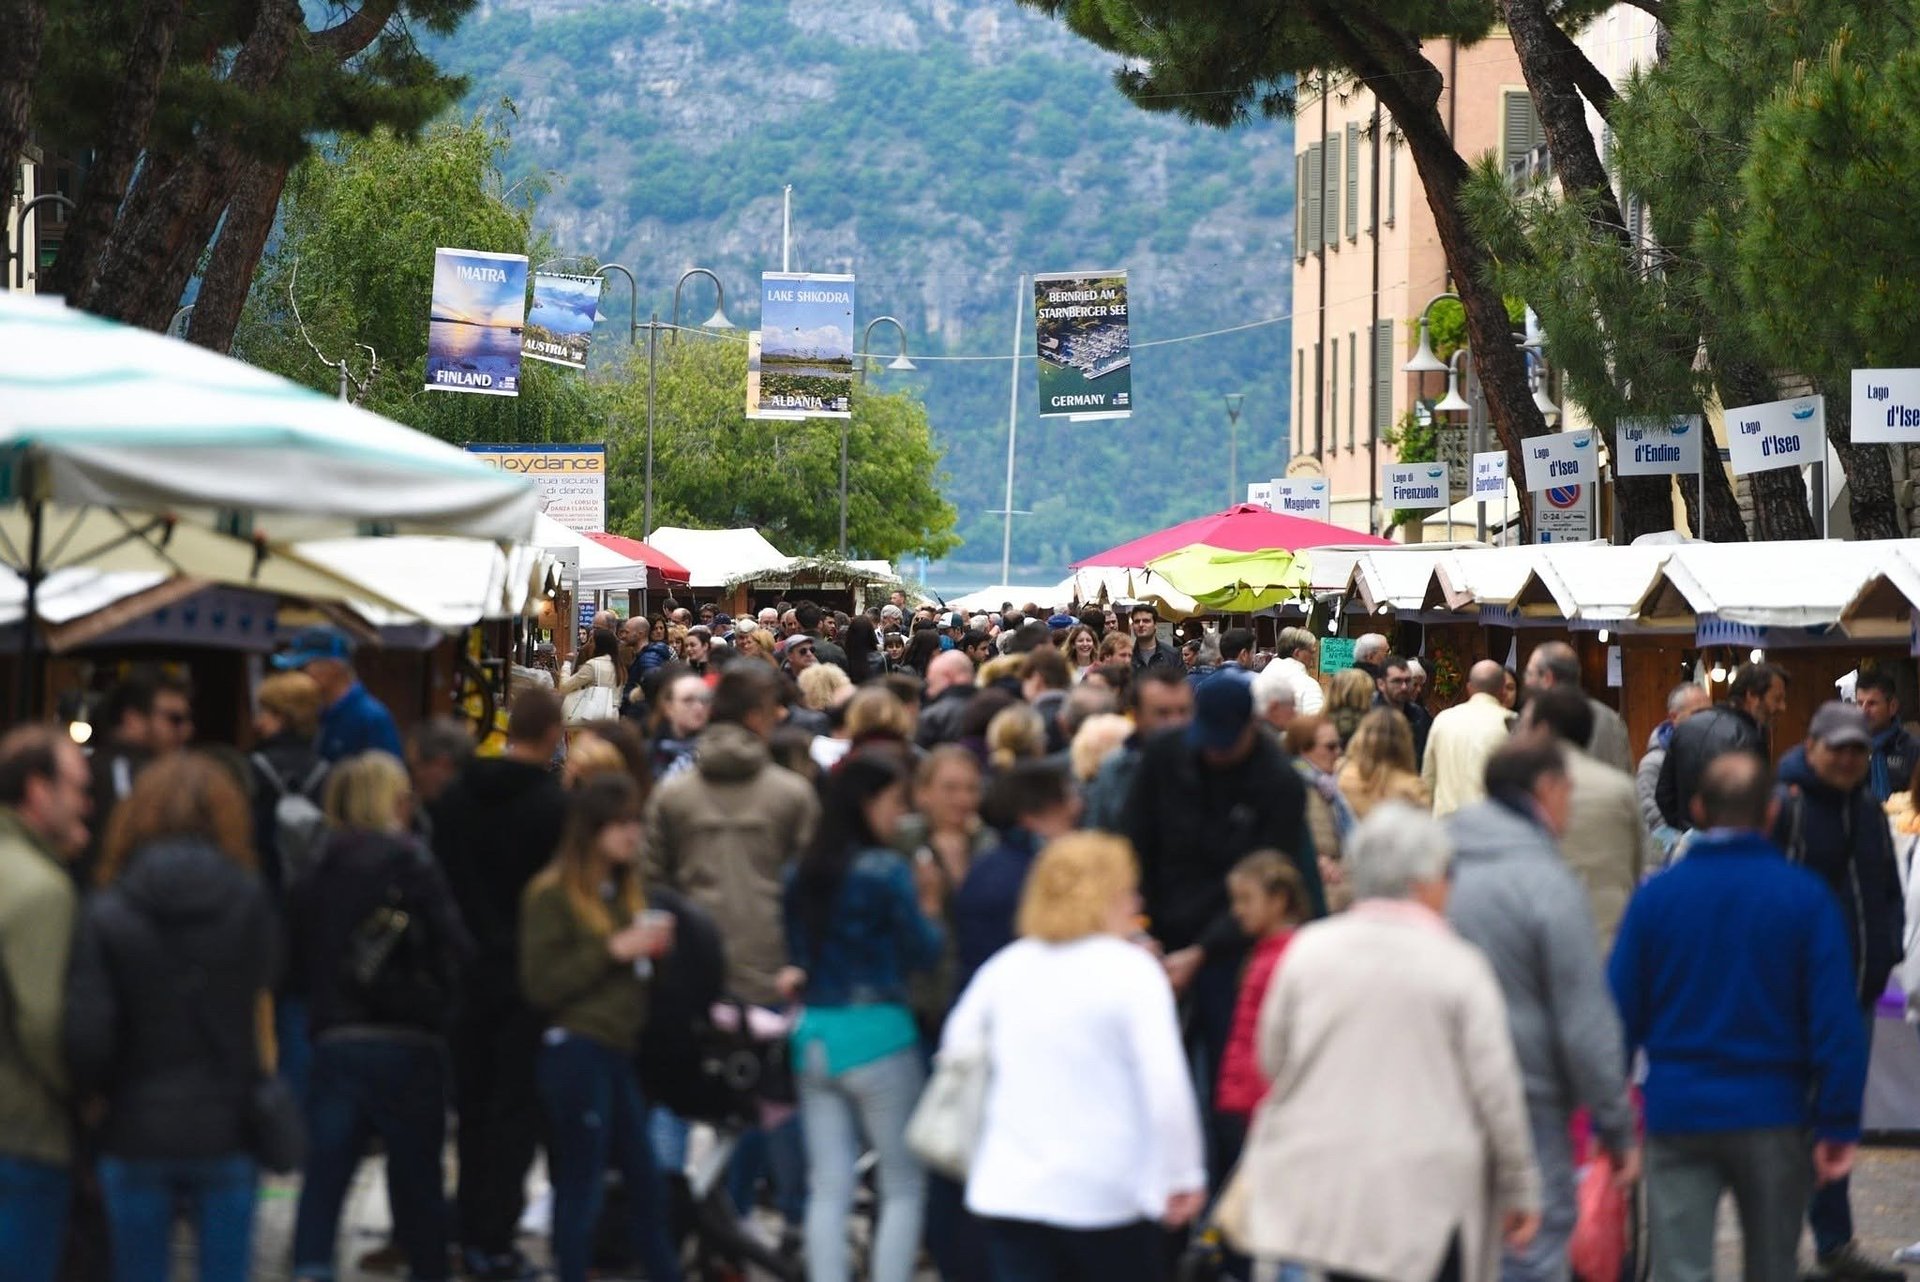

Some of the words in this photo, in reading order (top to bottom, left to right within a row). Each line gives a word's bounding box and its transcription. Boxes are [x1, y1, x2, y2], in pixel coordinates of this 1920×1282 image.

[456, 265, 507, 283] IMATRA
[768, 290, 794, 301] LAKE
[797, 291, 849, 303] SHKODRA
[1049, 290, 1098, 303] BERNRIED
[1100, 289, 1115, 300] AM
[1039, 306, 1107, 319] STARNBERGER
[1110, 304, 1127, 316] SEE
[525, 339, 568, 357] AUSTRIA
[436, 369, 492, 387] FINLAND
[1867, 384, 1889, 401] Lago
[771, 395, 823, 408] ALBANIA
[1051, 394, 1106, 407] GERMANY
[1625, 428, 1643, 442] Lago
[1740, 420, 1761, 435] Lago
[1762, 434, 1801, 456] d'Iseo
[1533, 447, 1550, 460] Lago
[1635, 444, 1680, 463] d'Endine
[1550, 459, 1579, 478] d'Iseo
[1392, 473, 1407, 484] Lago
[1407, 472, 1414, 482] di
[1279, 486, 1292, 495] Lago
[1393, 485, 1439, 500] Firenzuola
[1284, 497, 1320, 511] Maggiore
